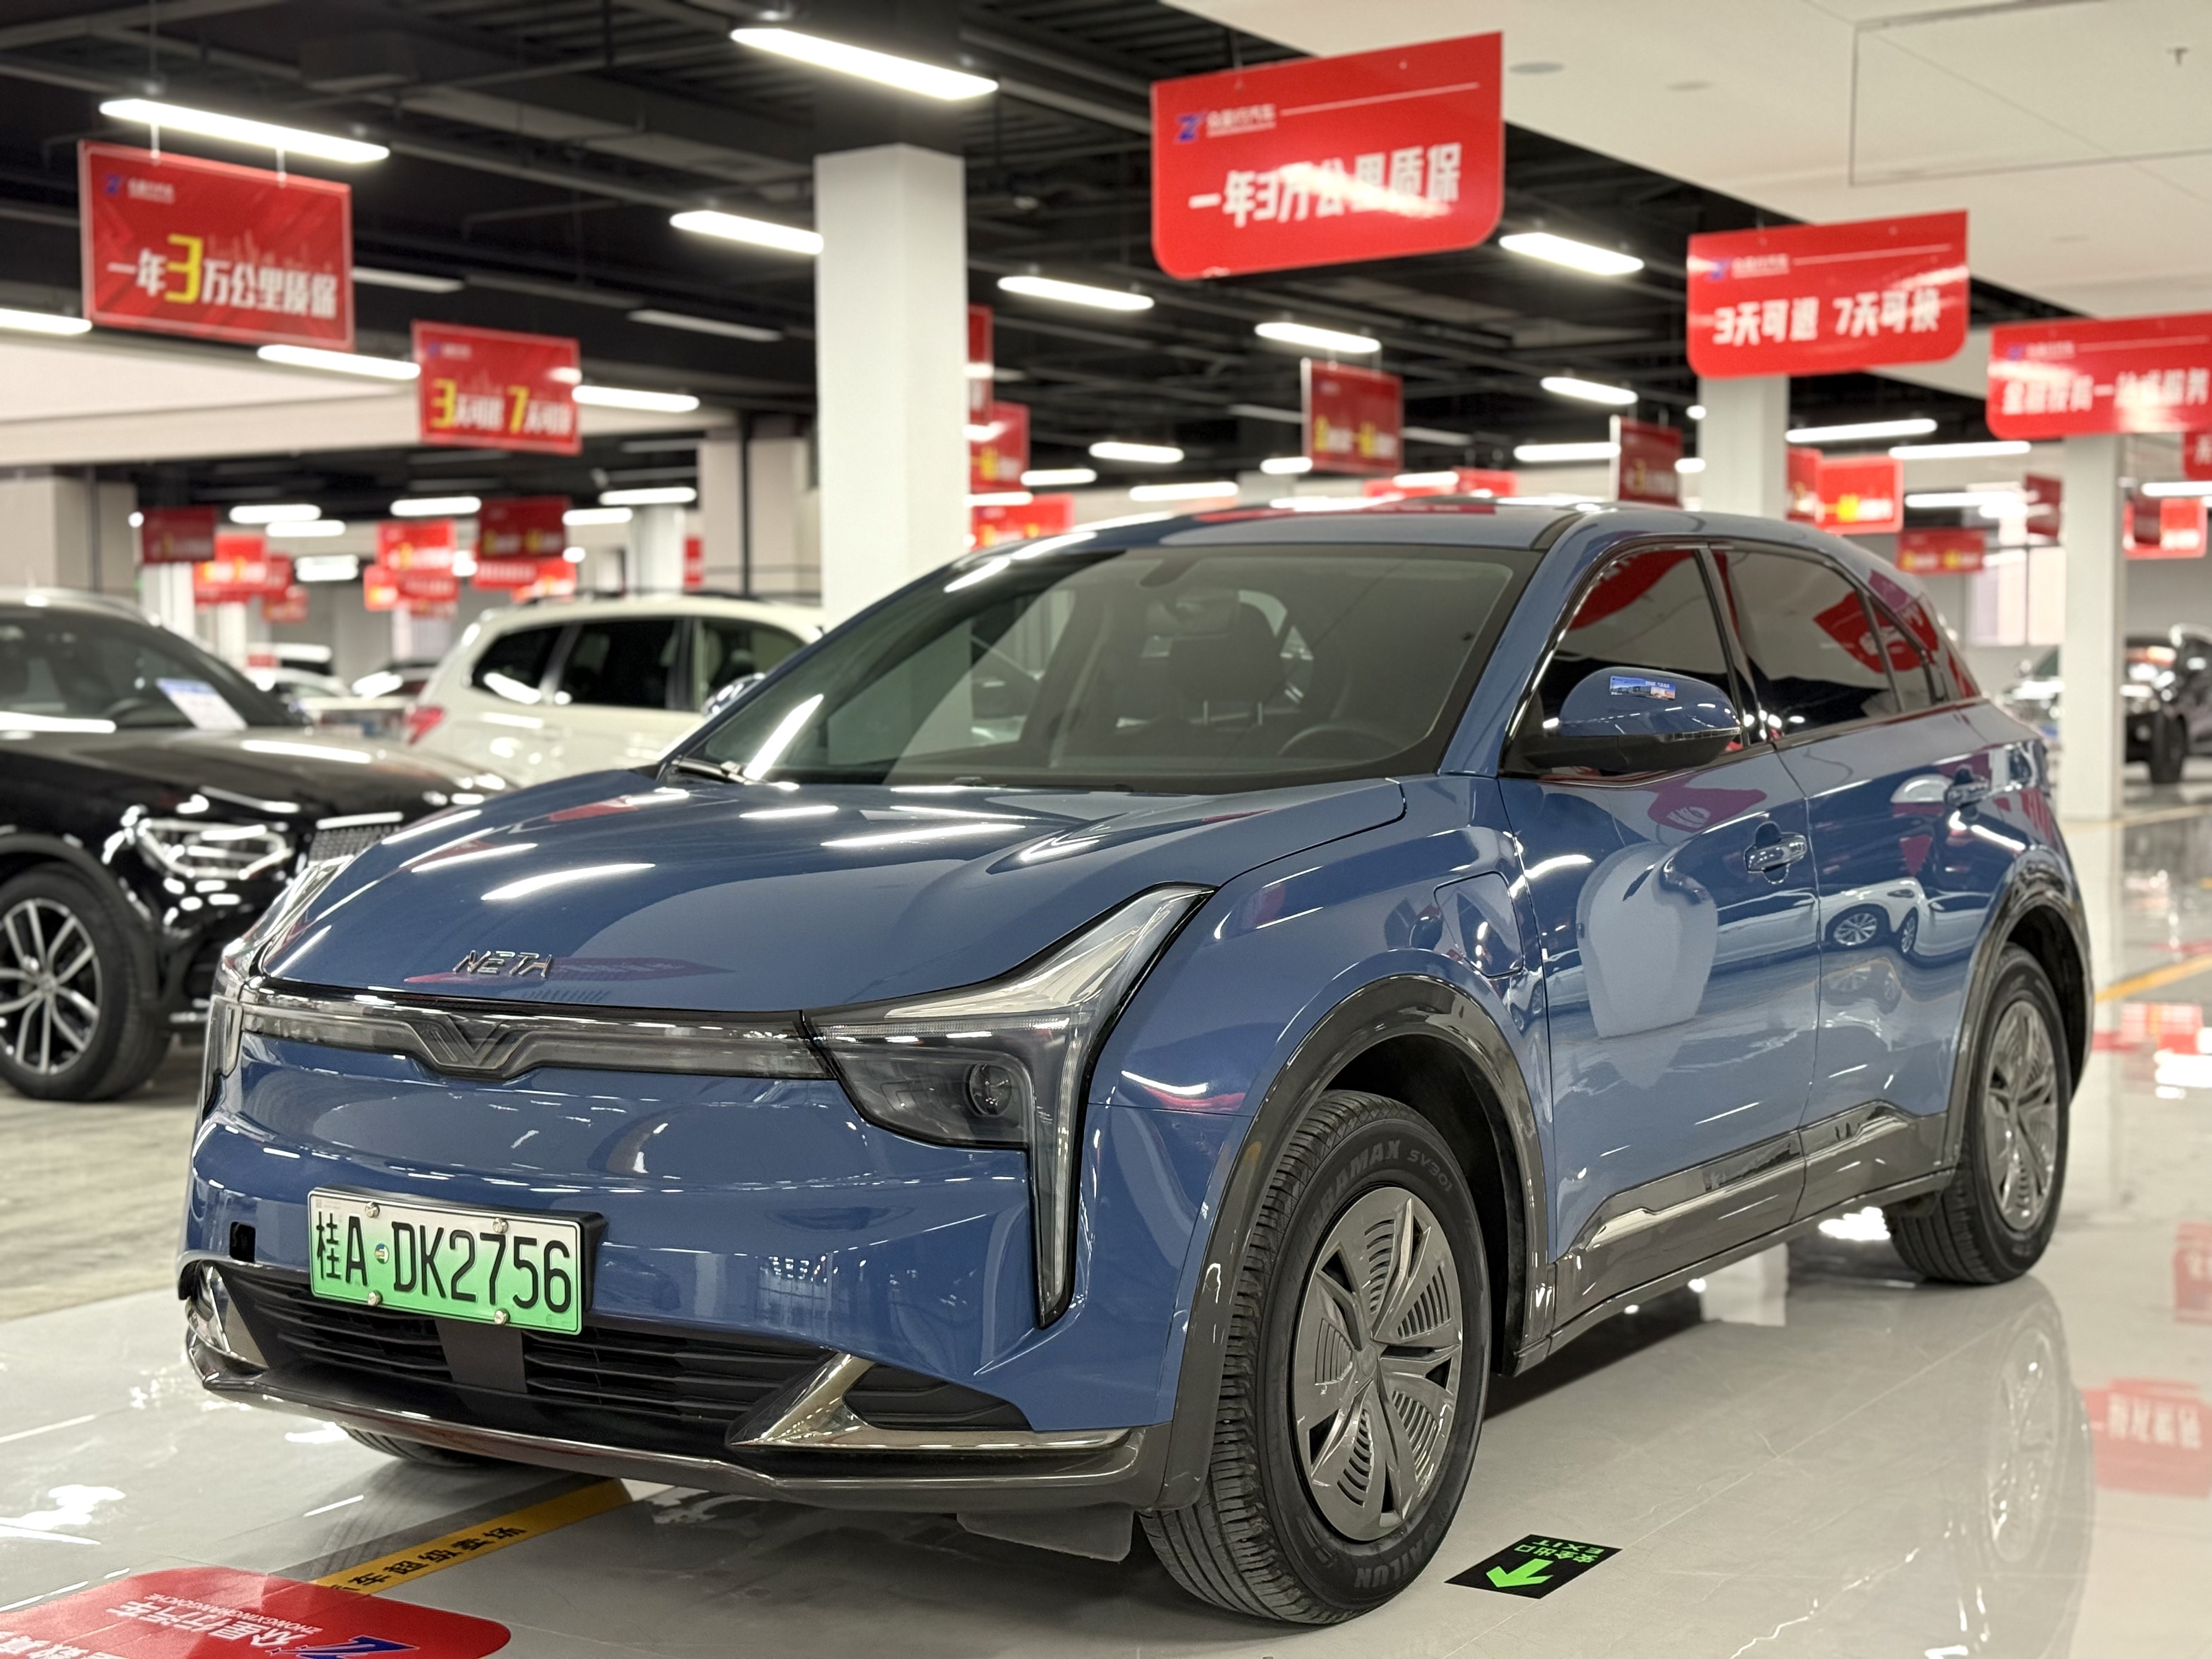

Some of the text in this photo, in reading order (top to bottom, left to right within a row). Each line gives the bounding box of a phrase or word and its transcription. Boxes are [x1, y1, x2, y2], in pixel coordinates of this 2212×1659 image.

[452, 949, 552, 979] NETA
[1514, 1544, 1599, 1564] 安全出口
[1532, 1539, 1605, 1555] EXIT
[105, 1600, 308, 1647] 众星行汽车
